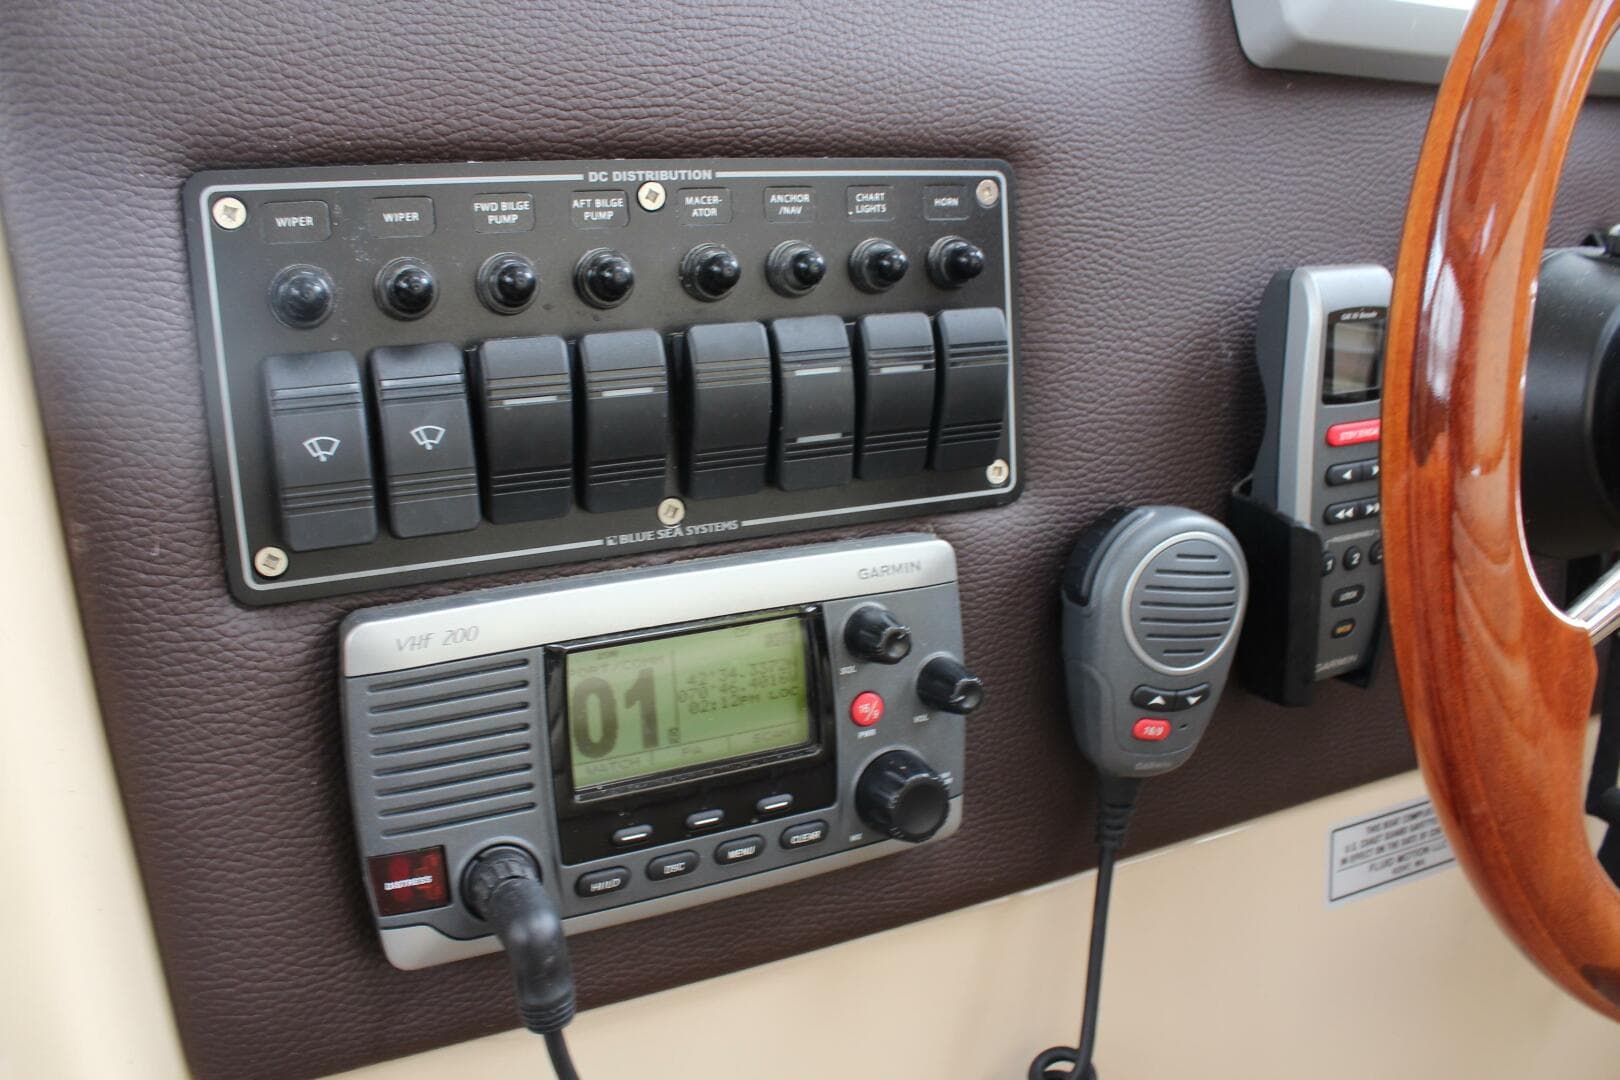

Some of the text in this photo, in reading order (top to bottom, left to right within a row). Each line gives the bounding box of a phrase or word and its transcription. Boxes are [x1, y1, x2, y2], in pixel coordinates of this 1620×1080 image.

[588, 169, 713, 182] DC DISTRIBUTION
[572, 197, 624, 209] AFT BILGE
[684, 195, 723, 206] MACER-
[769, 194, 810, 204] ANCHOR
[855, 192, 885, 203] CHART
[933, 197, 960, 207] HORN
[473, 200, 531, 213] FWD BILGE
[691, 207, 718, 218] ATOR
[855, 203, 887, 214] LIGHTS
[275, 214, 314, 228] WIPER
[382, 211, 420, 224] WIPER
[487, 213, 519, 225] PUMP
[583, 211, 614, 221] PUMP
[617, 520, 739, 545] BLUE SEA SYSTEMS
[1351, 552, 1361, 565] 2
[857, 560, 922, 580] GARMIN
[395, 625, 480, 652] VHF 200
[572, 666, 659, 758] 01
